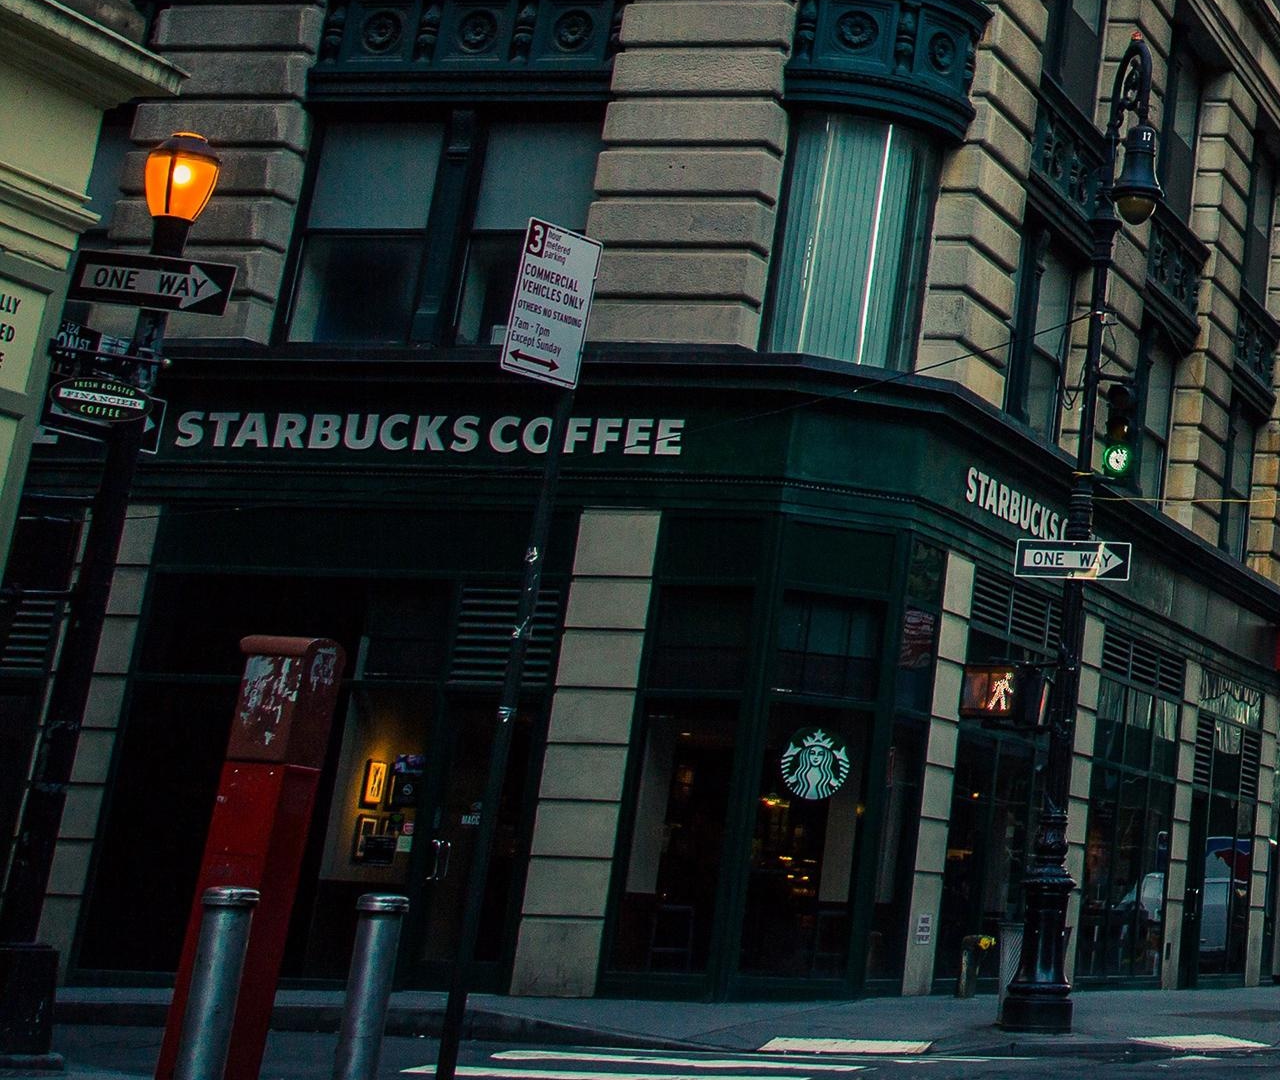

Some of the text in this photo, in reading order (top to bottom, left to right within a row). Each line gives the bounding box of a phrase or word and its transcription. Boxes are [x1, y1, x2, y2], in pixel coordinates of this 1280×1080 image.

[528, 224, 545, 254] 3
[93, 267, 210, 298] ONE WAY
[524, 263, 579, 293] COMMERCIAL
[522, 278, 585, 311] VEHICLES ONLY
[513, 316, 530, 331] 7am
[534, 321, 551, 338] 7pm
[517, 299, 583, 329] OTHERS NO STANDING
[510, 329, 562, 357] Except Sunday
[79, 403, 121, 418] COFFEE
[174, 411, 686, 456] STARBUCKS COFFEE
[965, 466, 1059, 540] STARBUCKS
[1033, 551, 1113, 568] ONE WAY
